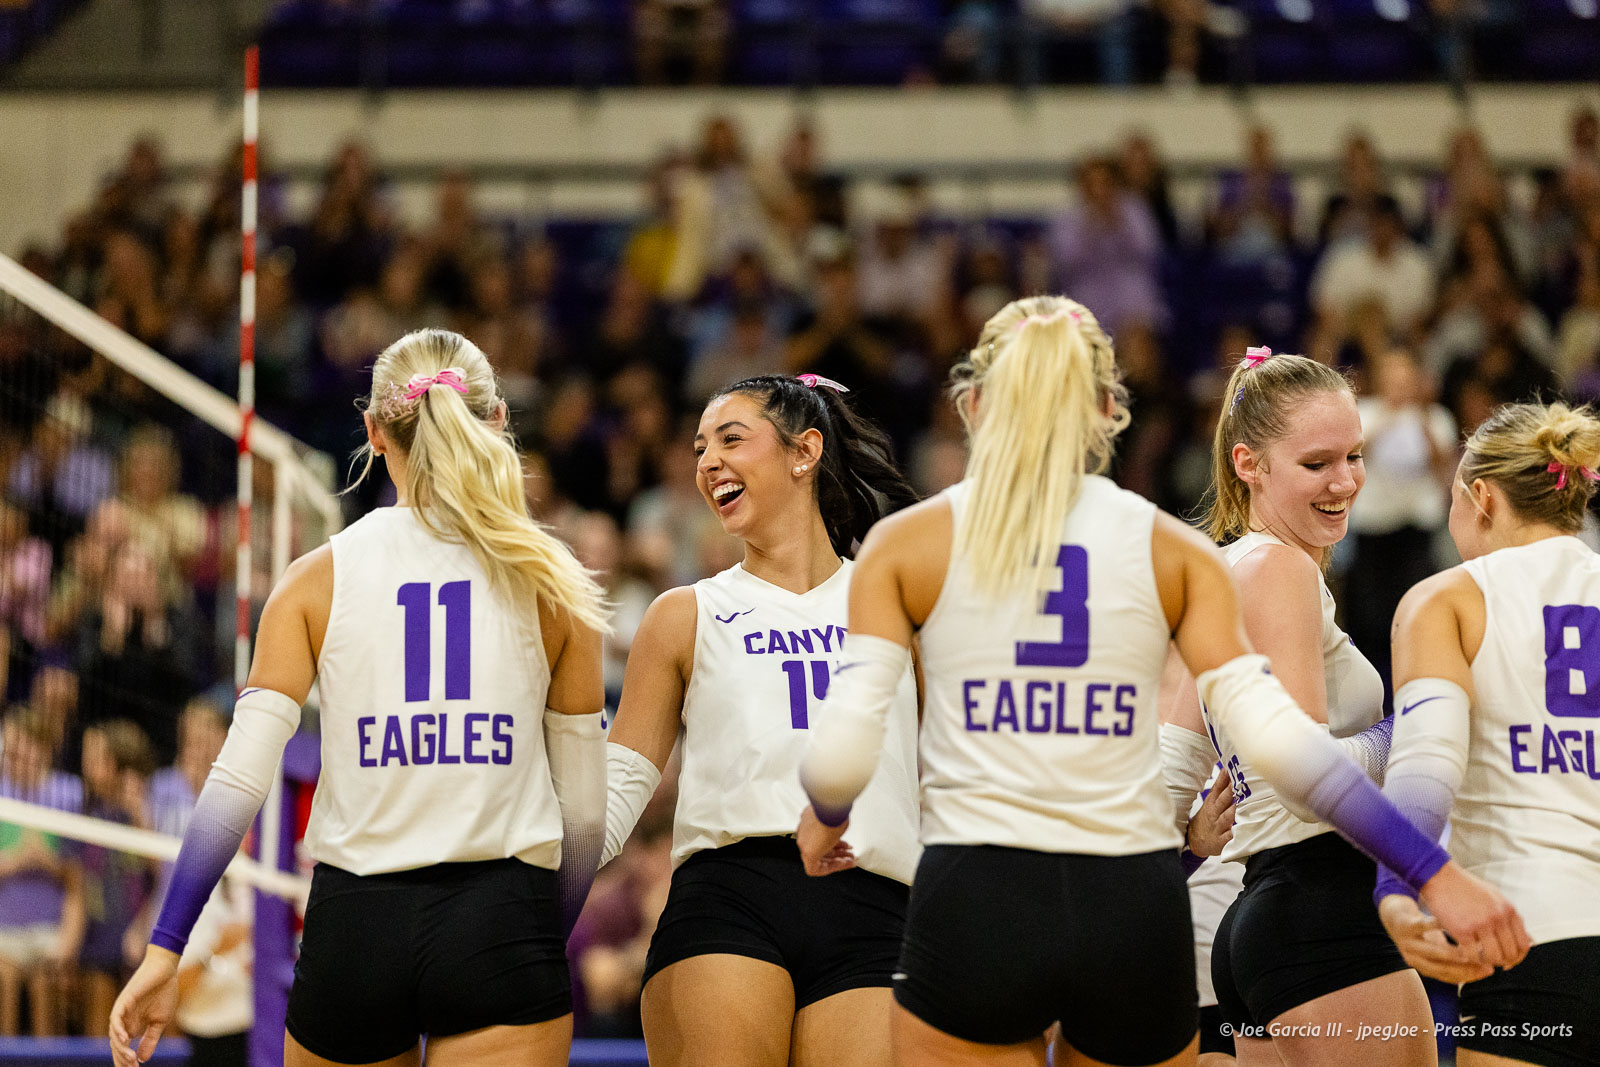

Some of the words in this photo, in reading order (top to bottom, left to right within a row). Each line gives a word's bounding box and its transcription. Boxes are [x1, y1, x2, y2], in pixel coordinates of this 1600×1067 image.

[397, 580, 471, 702] 11
[1015, 544, 1090, 668] 3
[1543, 604, 1600, 718] 8
[357, 713, 514, 767] EAGLES
[963, 680, 1137, 736] EAGLES
